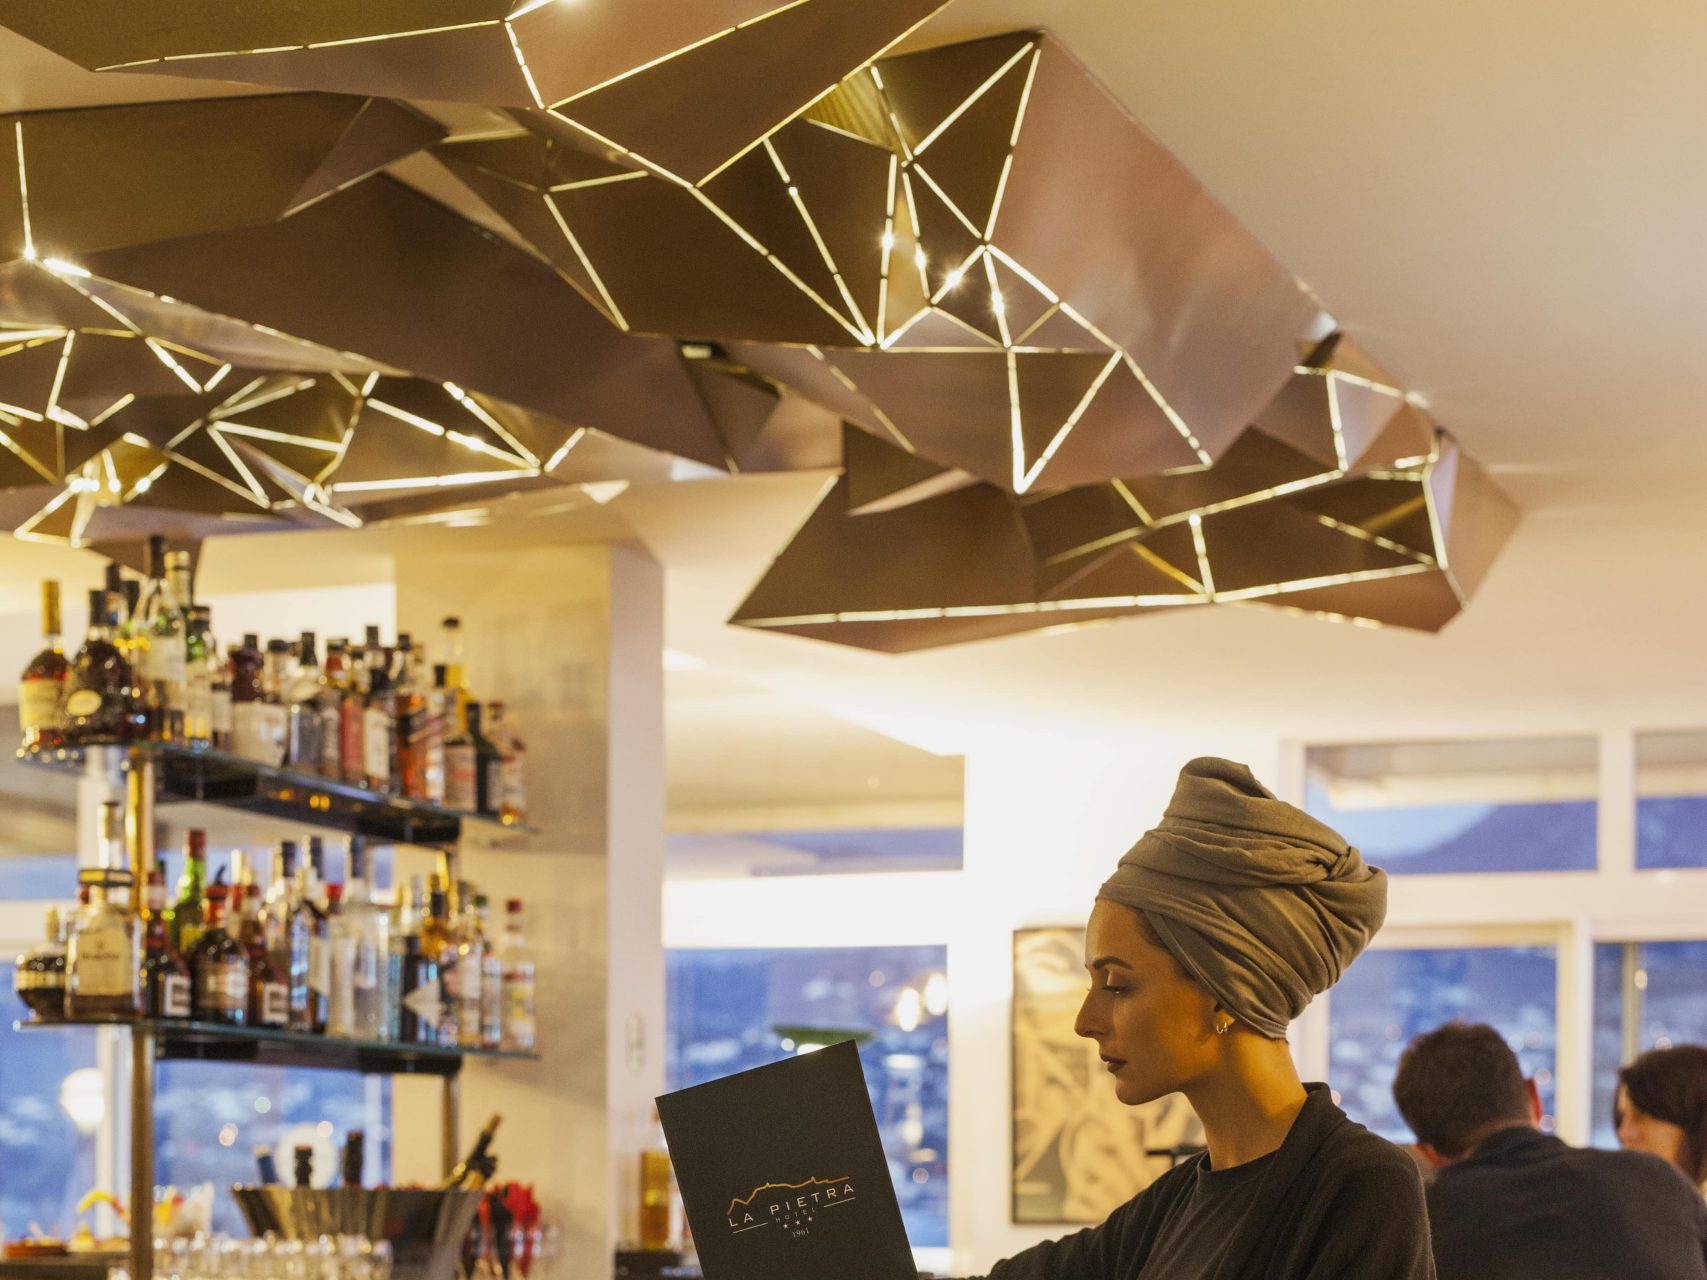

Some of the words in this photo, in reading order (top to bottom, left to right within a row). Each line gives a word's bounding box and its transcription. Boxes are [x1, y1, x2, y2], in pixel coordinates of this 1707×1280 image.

[728, 1213, 754, 1227] LA
[769, 1183, 854, 1215] PIETRA
[775, 1207, 816, 1223] HOTEL
[792, 1227, 809, 1239] 1961
